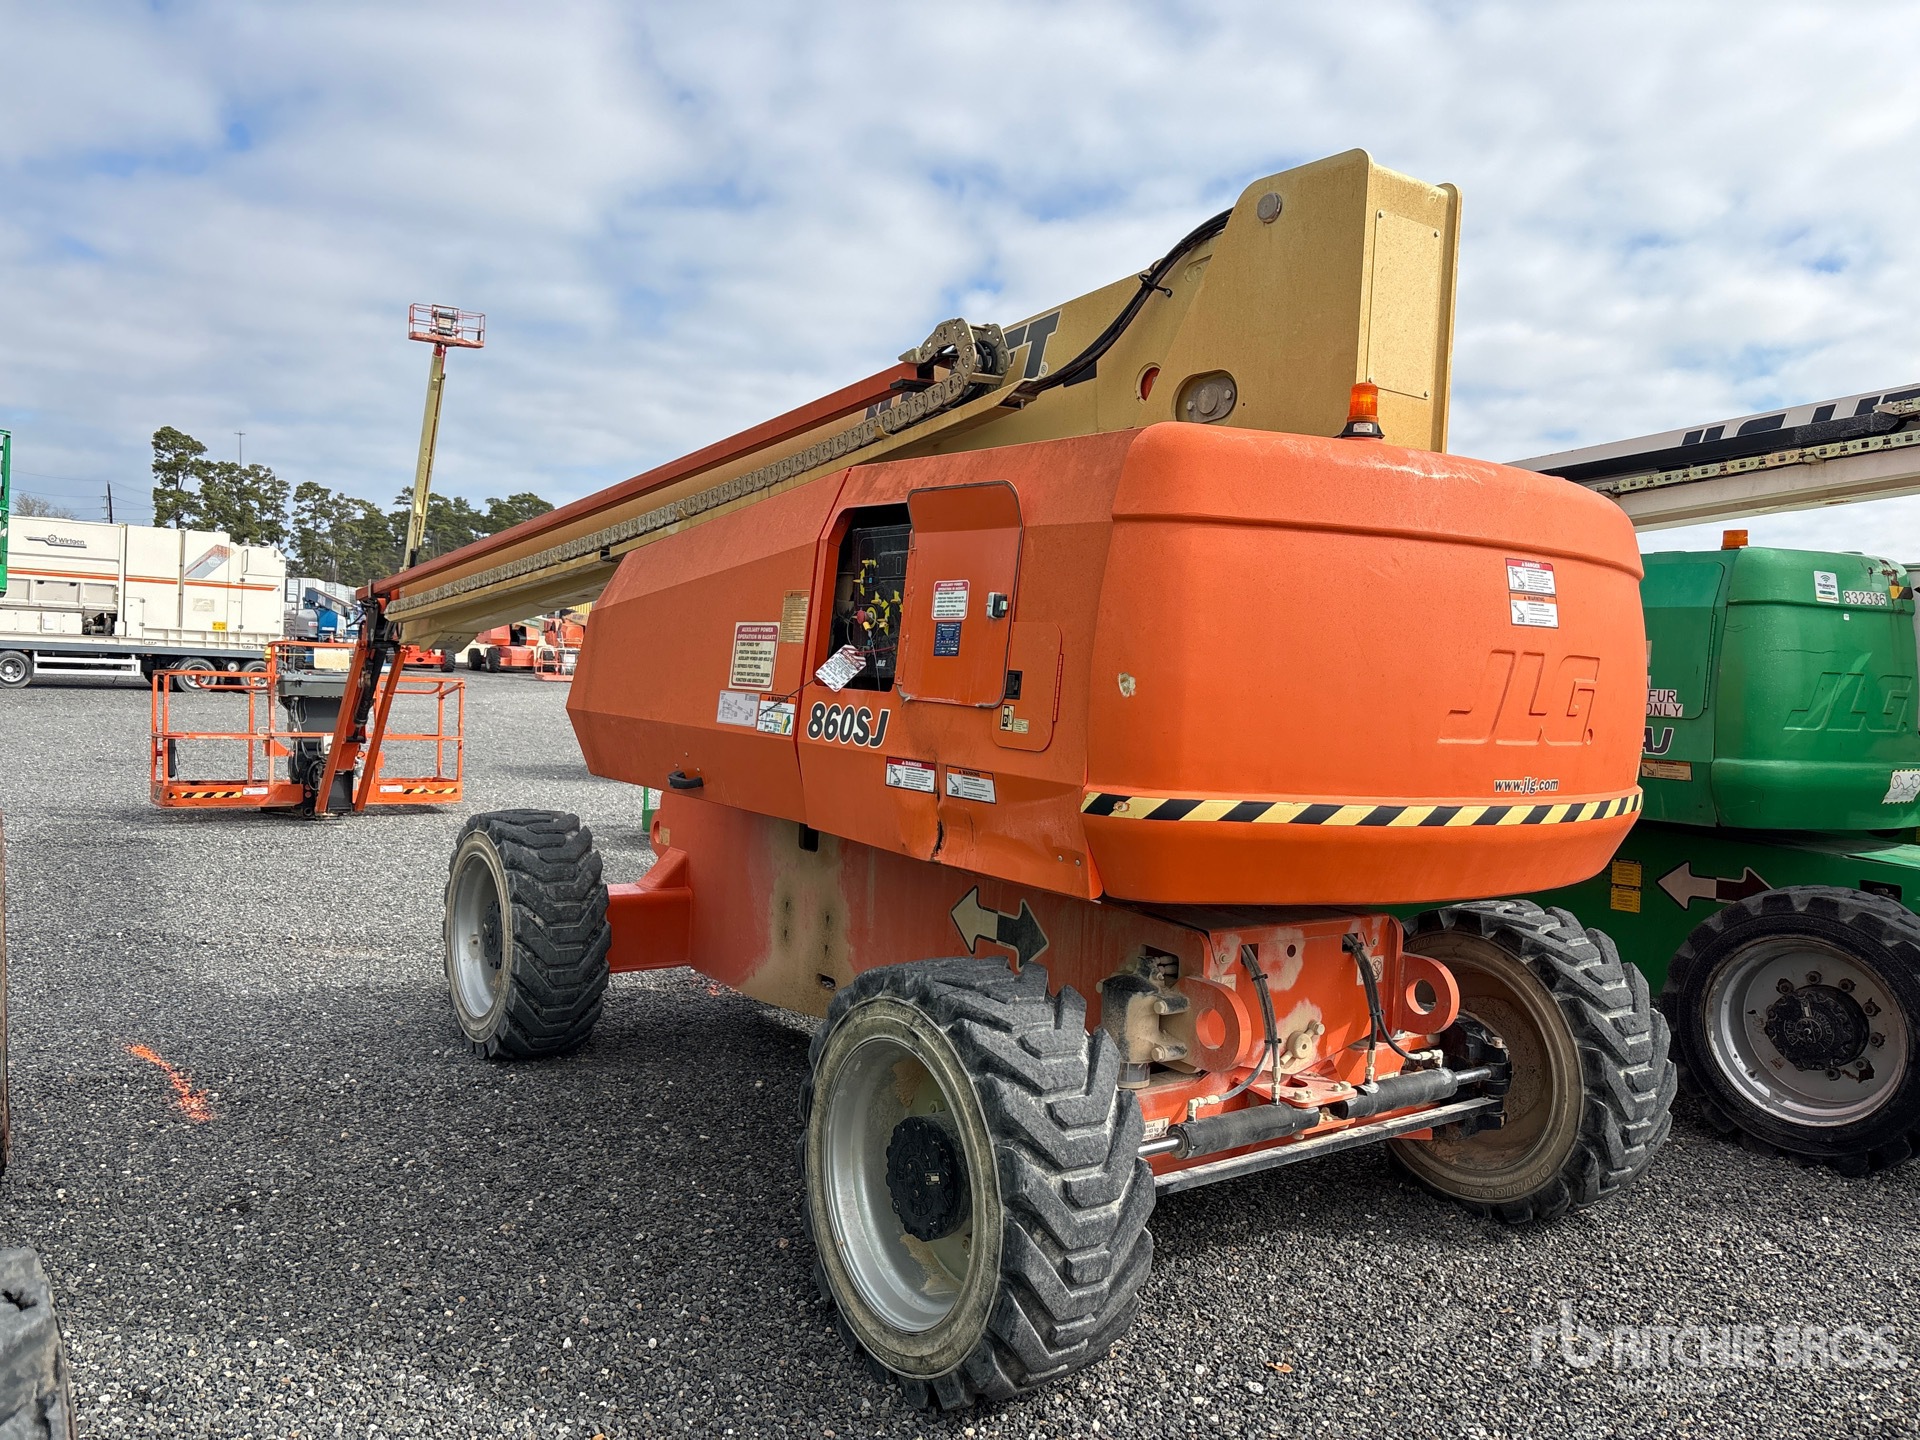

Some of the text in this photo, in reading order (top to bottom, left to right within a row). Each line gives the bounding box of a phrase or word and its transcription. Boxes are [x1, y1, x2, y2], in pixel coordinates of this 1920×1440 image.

[58, 537, 85, 546] Wirtgen
[1437, 650, 1600, 746] JLG
[1648, 689, 1676, 703] FUR
[1783, 671, 1912, 733] JLG
[1646, 703, 1682, 717] ONLY
[807, 701, 891, 748] 860SJ
[1494, 777, 1559, 794] www.jlg.com
[1459, 1163, 1551, 1199] OUTRIGGER
